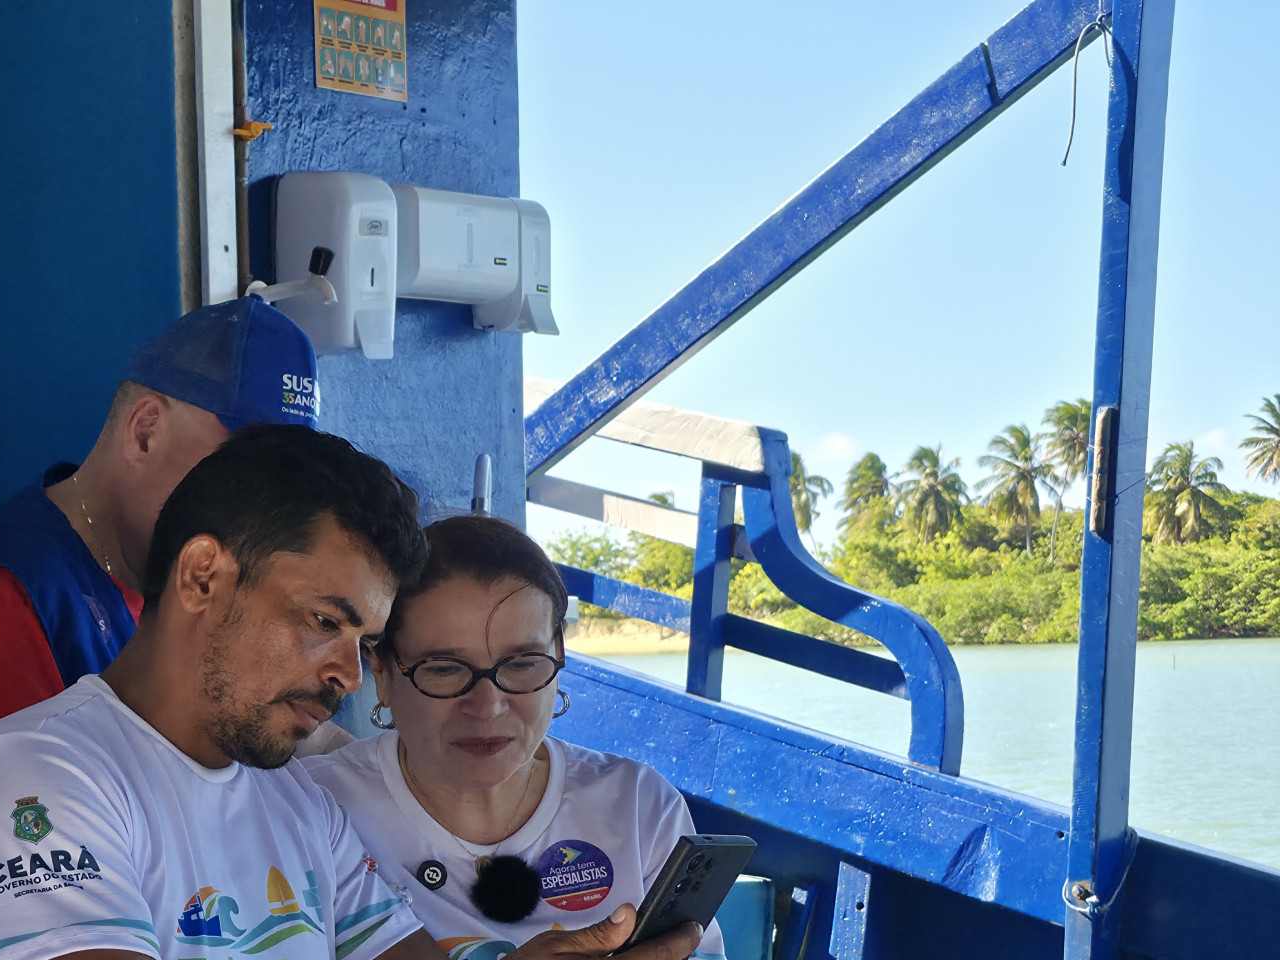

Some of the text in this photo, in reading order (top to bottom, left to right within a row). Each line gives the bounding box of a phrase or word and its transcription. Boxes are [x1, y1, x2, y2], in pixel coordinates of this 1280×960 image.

[282, 374, 313, 393] SUS
[549, 861, 596, 875] Agora tem
[42, 872, 60, 882] DO
[60, 872, 103, 882] ESTADO
[541, 866, 608, 890] ESPECIALISTAS
[13, 886, 53, 899] SECRETARIA
